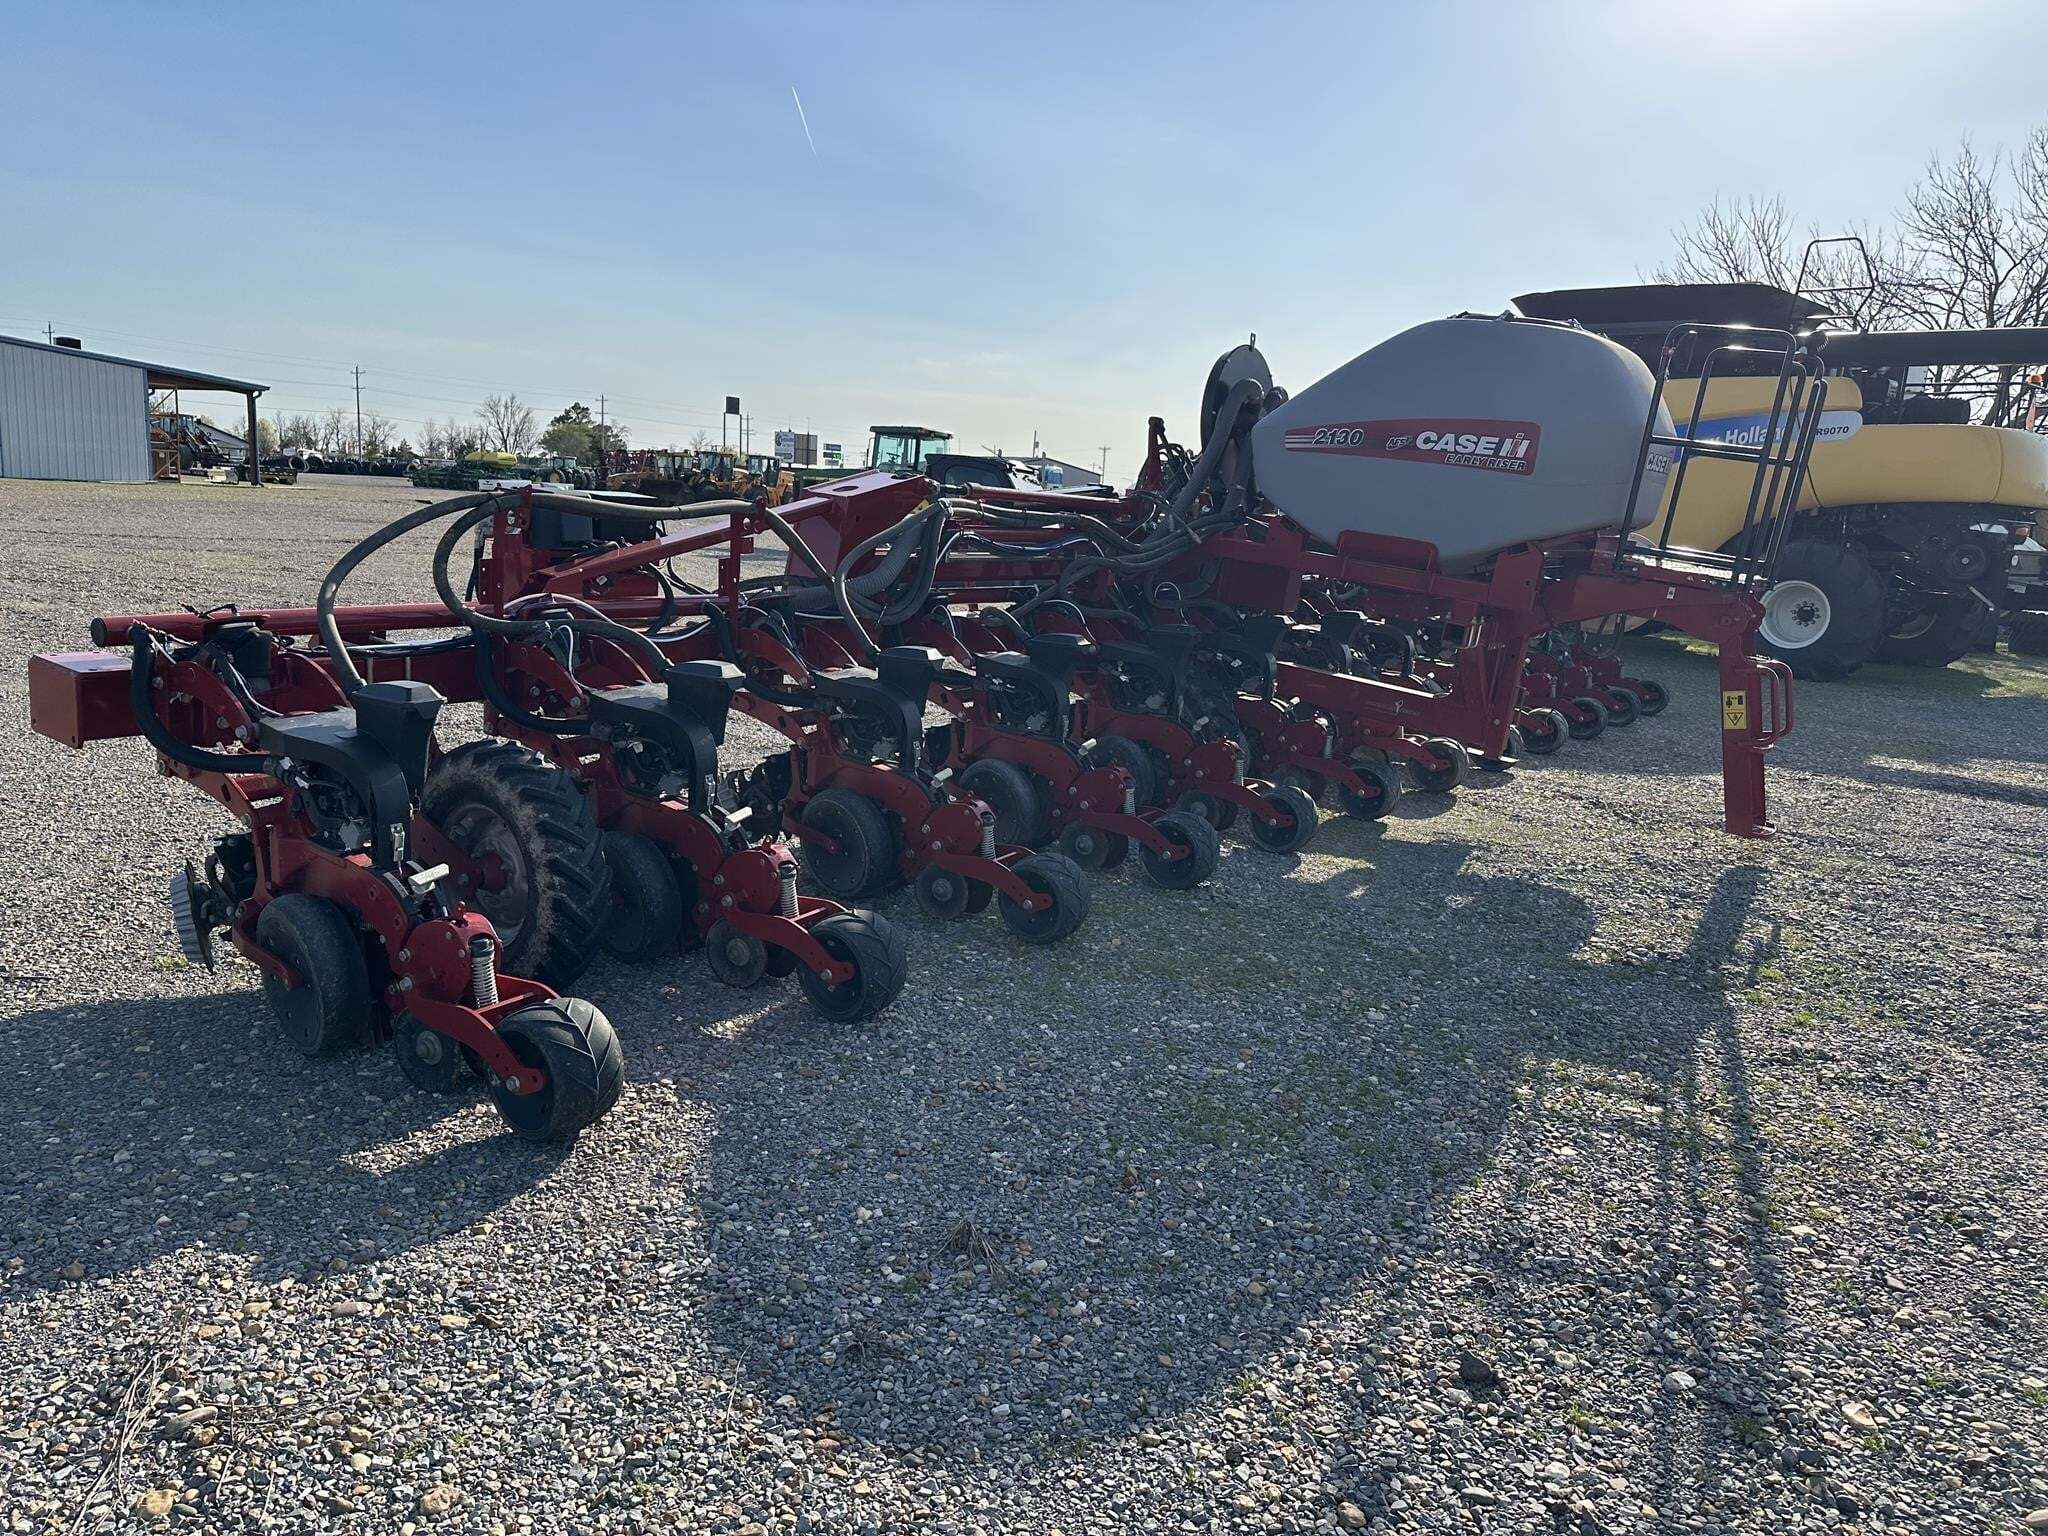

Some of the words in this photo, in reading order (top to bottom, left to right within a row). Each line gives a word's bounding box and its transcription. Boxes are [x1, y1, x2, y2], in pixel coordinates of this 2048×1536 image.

[1312, 427, 1365, 447] 2130
[1415, 431, 1499, 455] CASE
[1725, 425, 1786, 444] Holla
[1445, 453, 1487, 466] EARLY
[1487, 457, 1527, 471] RISER
